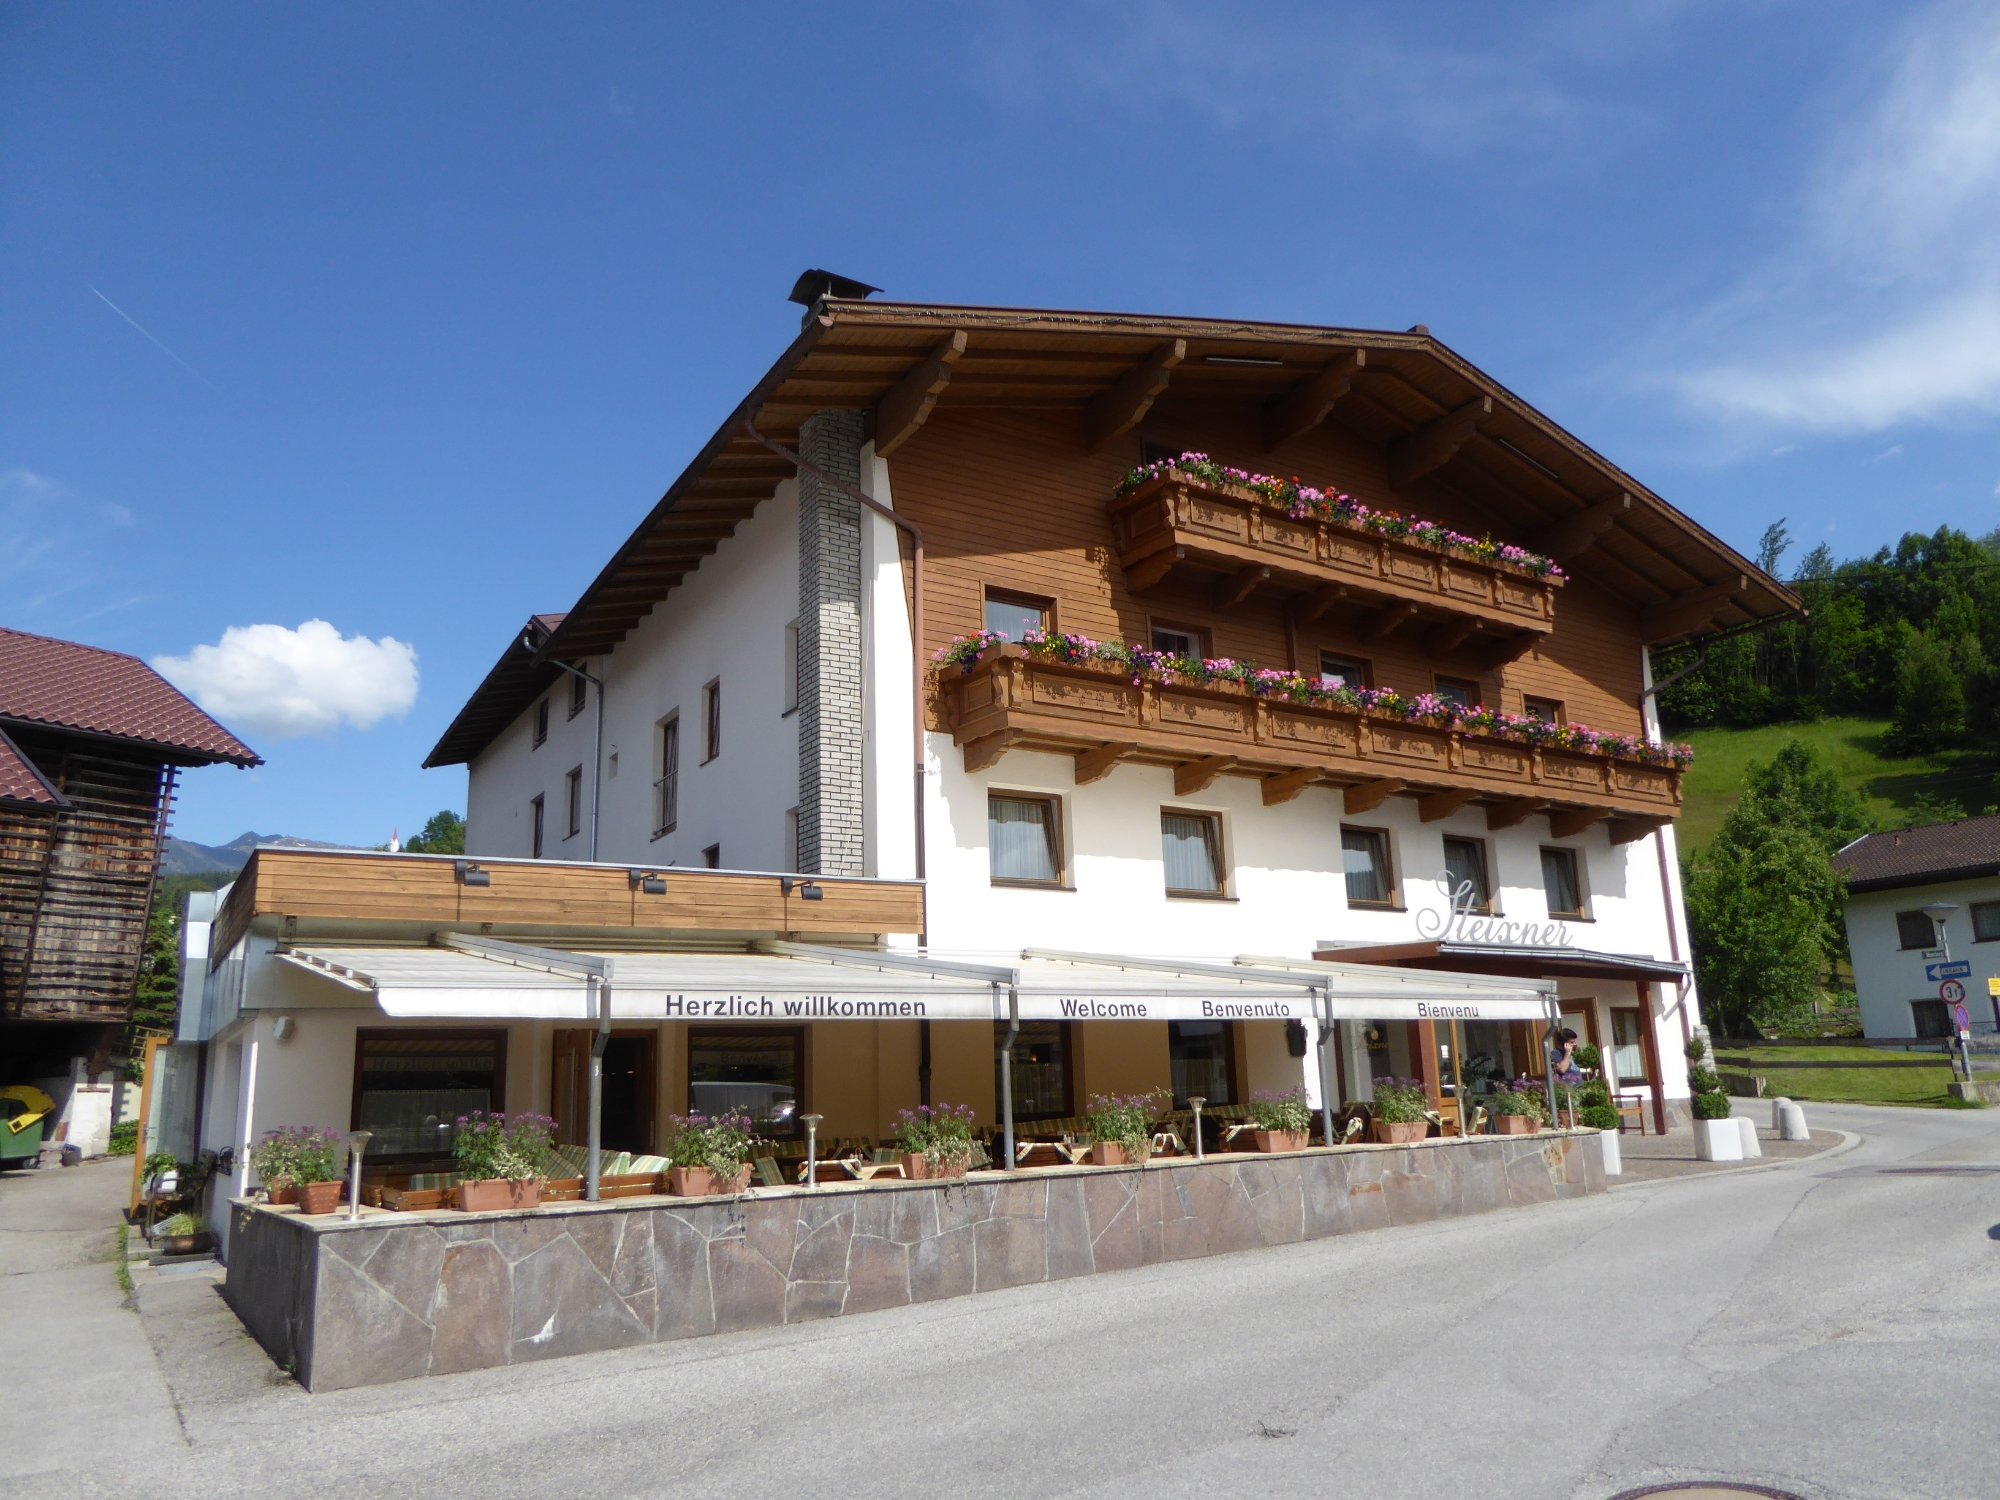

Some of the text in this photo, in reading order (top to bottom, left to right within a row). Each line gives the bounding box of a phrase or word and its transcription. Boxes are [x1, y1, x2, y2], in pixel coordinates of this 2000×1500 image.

[1416, 870, 1573, 946] Steixner
[666, 995, 926, 1017] Herzlich willkommen
[1060, 999, 1147, 1017] Welcome
[1201, 1000, 1290, 1017] Benvenuto
[1417, 1002, 1479, 1017] Bienvenu
